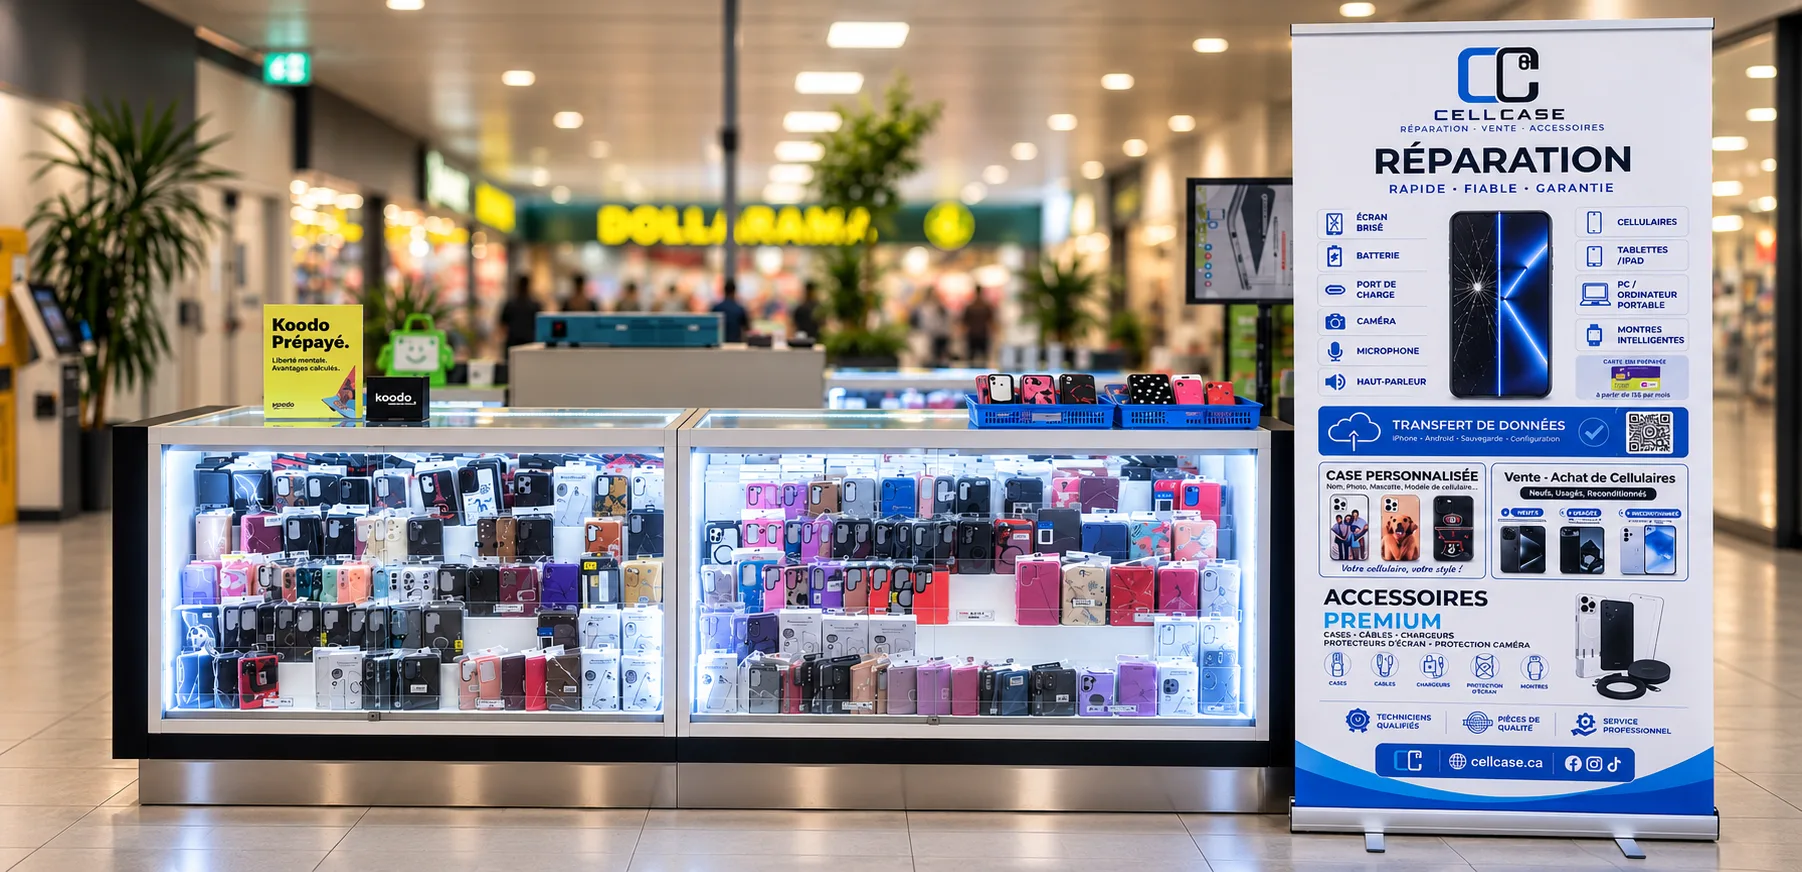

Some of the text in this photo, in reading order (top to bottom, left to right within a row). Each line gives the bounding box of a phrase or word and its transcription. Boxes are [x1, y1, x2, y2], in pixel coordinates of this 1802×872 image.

[1435, 109, 1564, 120] CELLCASE
[1401, 124, 1468, 132] RÉPARATION
[1376, 141, 1630, 174] RÉPARATION
[1390, 183, 1613, 193] RAPIDE FIABLE GARANTIE
[1357, 212, 1387, 221] ÉCRAN
[1357, 223, 1383, 231] BRISÉ
[1618, 218, 1677, 226] CELLULAIRES
[273, 318, 329, 331] Koodo
[1357, 316, 1396, 325] CAMÉRA
[273, 334, 349, 352] Prépayé.
[375, 392, 412, 403] koodo
[1393, 418, 1565, 430] TRANSFERT DE DONNÉES
[1326, 468, 1478, 481] CASE PERSONNALISÉE
[1504, 472, 1541, 482] Vente
[1551, 472, 1588, 482] Achat
[1591, 472, 1607, 483] de
[1610, 473, 1675, 483] Cellulaires
[1436, 565, 1456, 575] style
[1324, 589, 1488, 606] ACCESSOIRES
[1324, 612, 1441, 629] PREMIUM
[1400, 632, 1455, 640] CHARGEURS
[1389, 639, 1425, 647] D'ÉCRAN
[1376, 713, 1432, 721] TECHNICIENS
[1527, 716, 1541, 724] DE
[1604, 724, 1671, 734] PROFESSIONNEL
[1471, 756, 1543, 768] cellcase.ca
